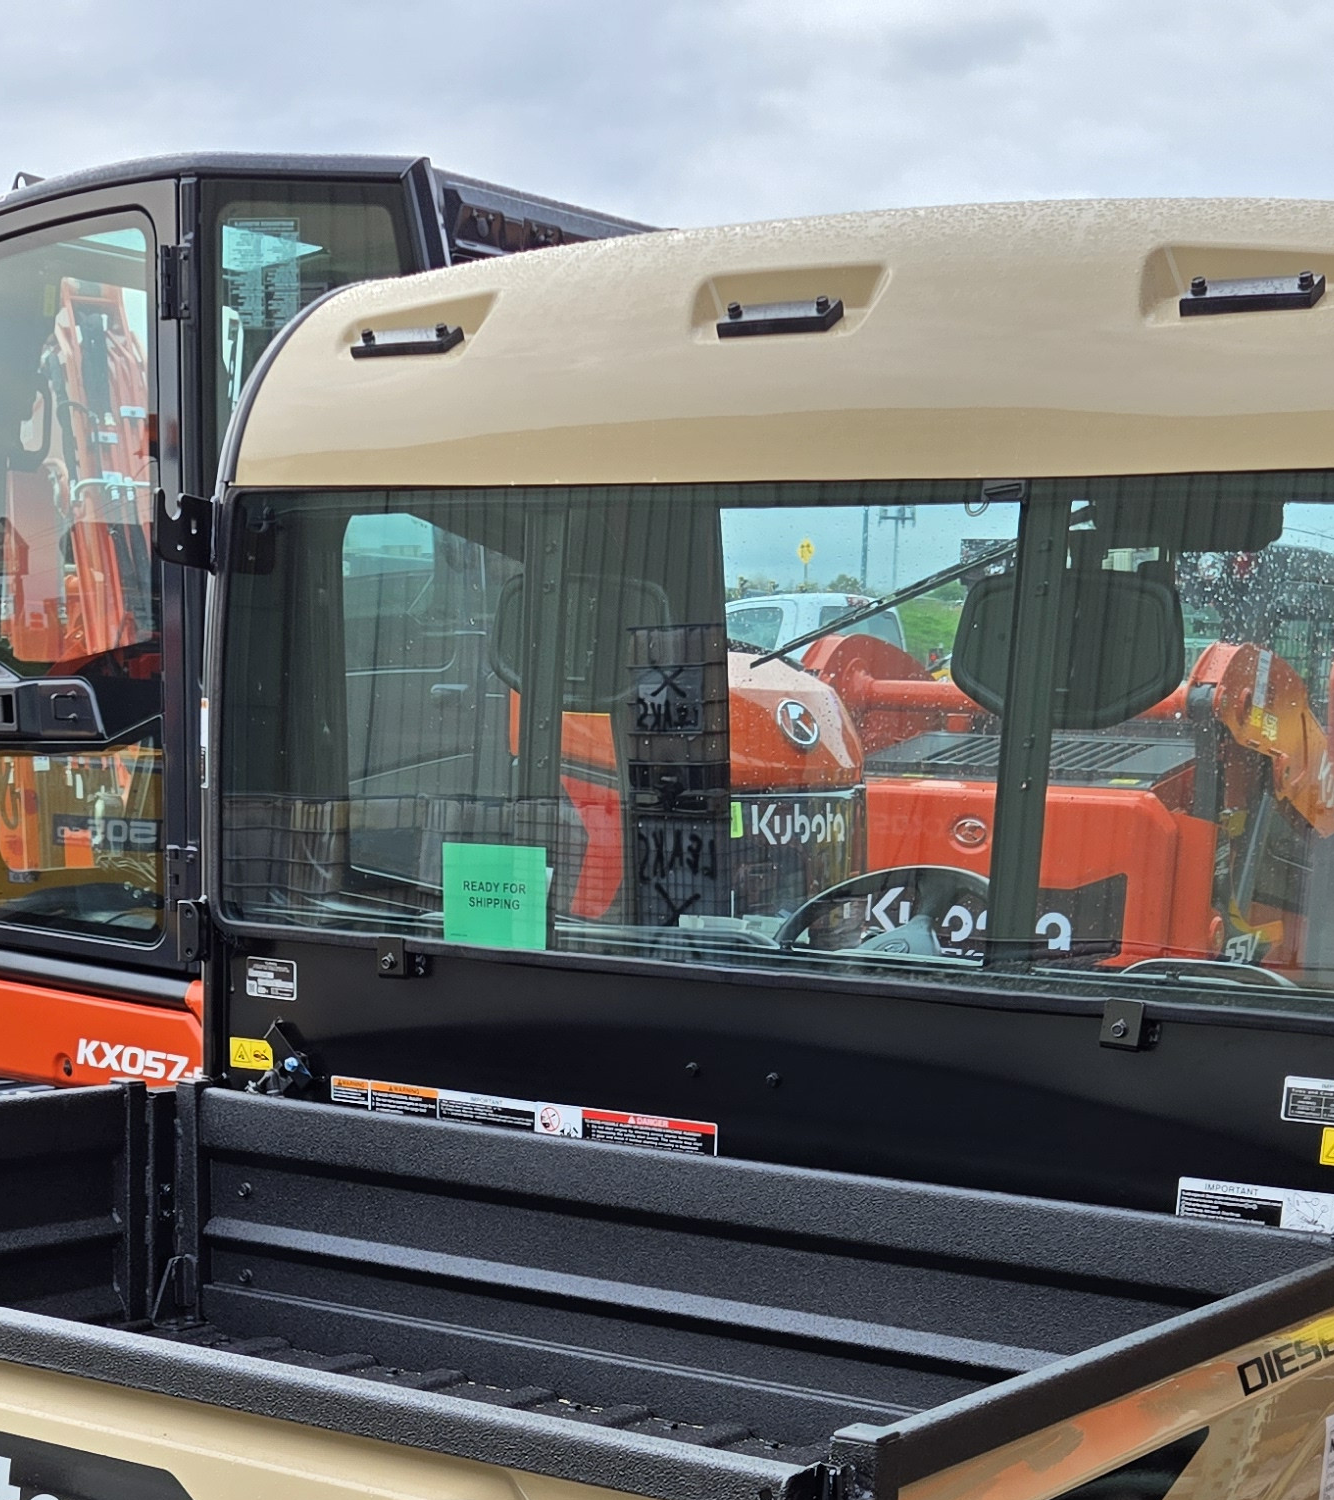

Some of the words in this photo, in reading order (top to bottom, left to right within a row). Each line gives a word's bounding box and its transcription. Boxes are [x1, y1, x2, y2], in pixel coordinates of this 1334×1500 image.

[751, 802, 845, 845] Kubota
[463, 881, 499, 892] READY
[503, 883, 526, 894] FOR
[469, 897, 520, 910] SHIPPING
[636, 1116, 670, 1128] DANGER
[1204, 1183, 1259, 1196] IMPORTANT
